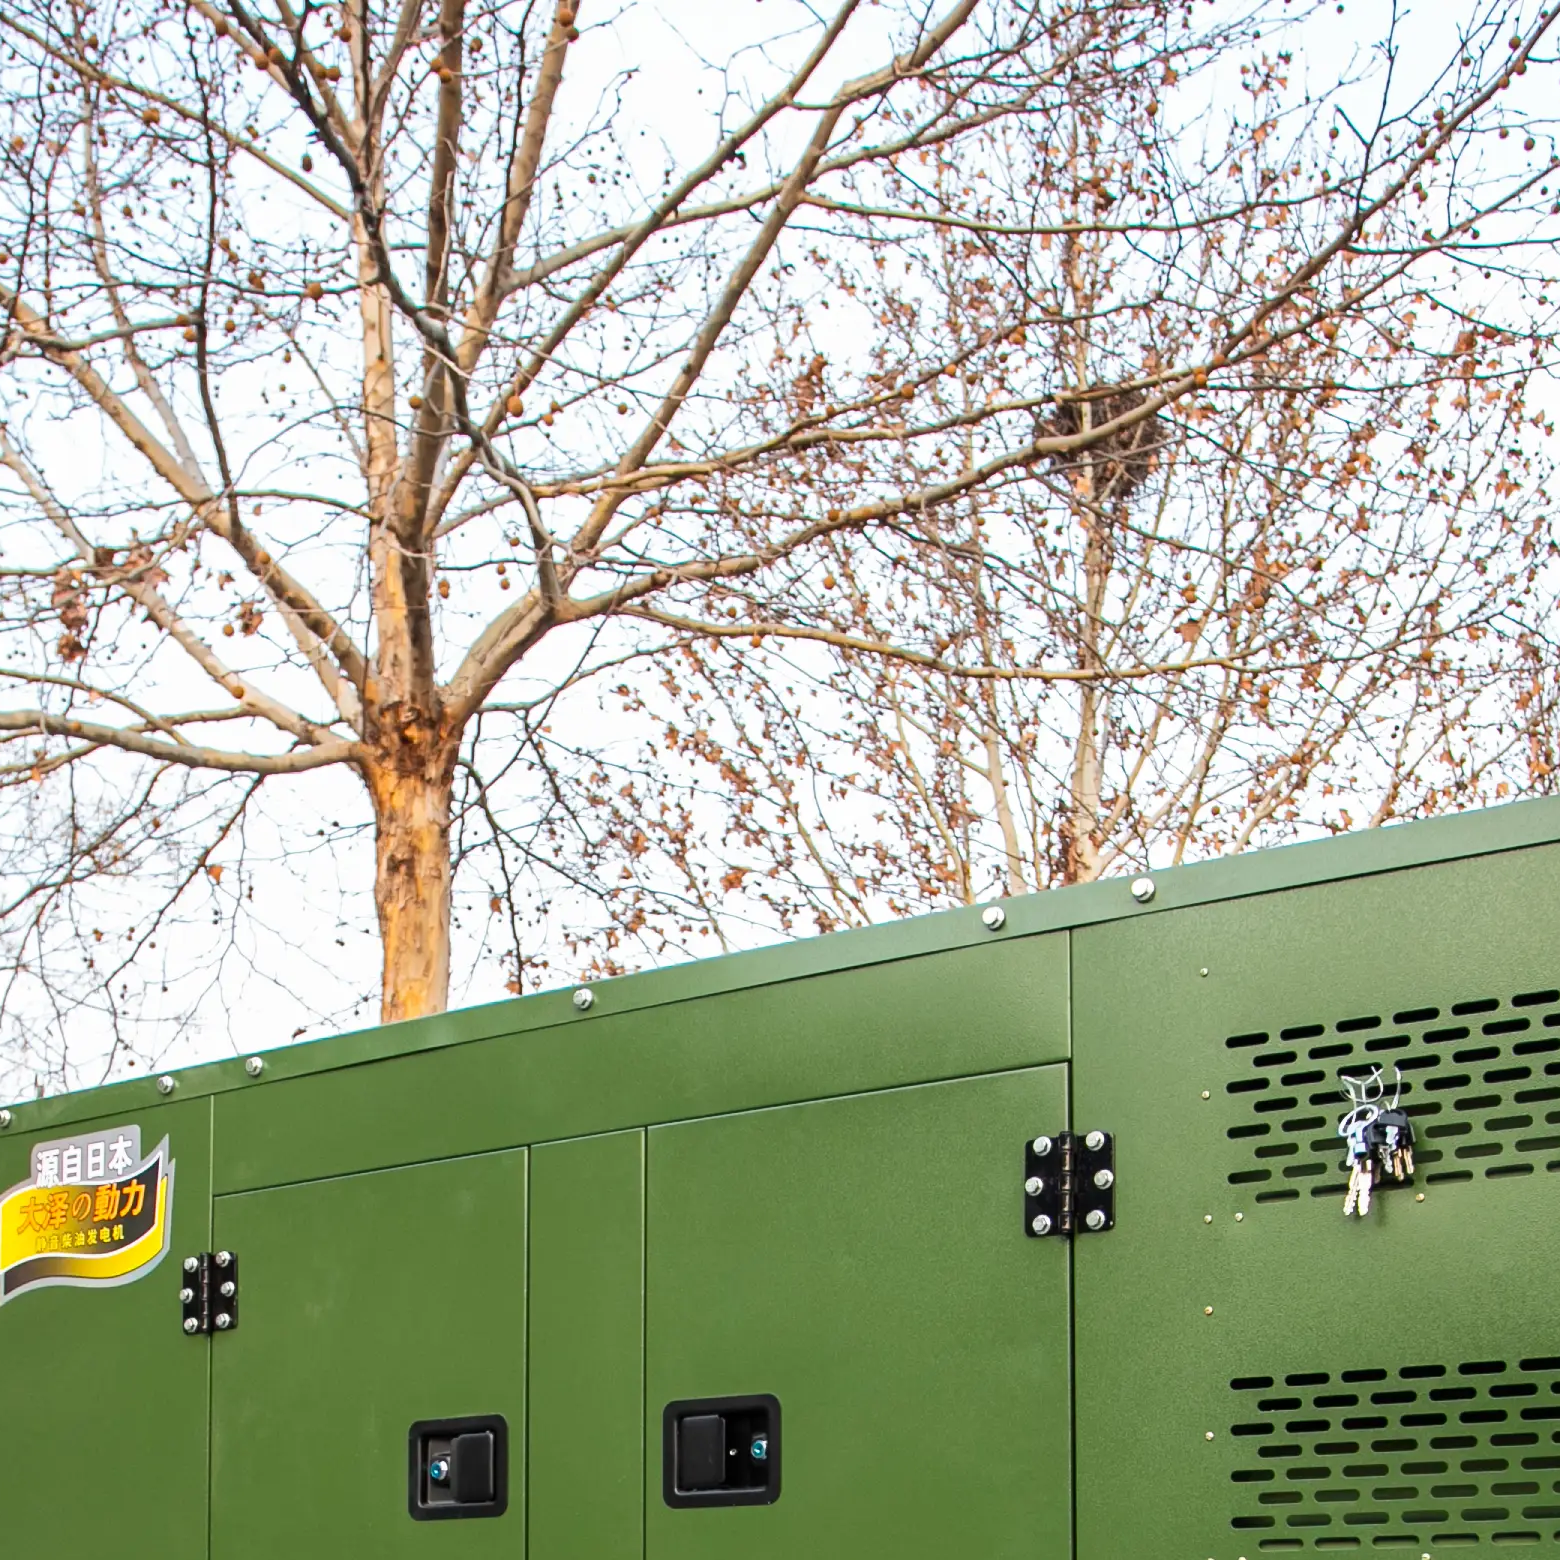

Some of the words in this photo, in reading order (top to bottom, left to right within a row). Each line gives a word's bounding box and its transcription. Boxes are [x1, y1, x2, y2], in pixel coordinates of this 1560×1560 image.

[36, 1134, 133, 1189] 源自日本
[17, 1178, 146, 1235] 大泽の動力
[35, 1224, 125, 1253] 静音柴油发电机
